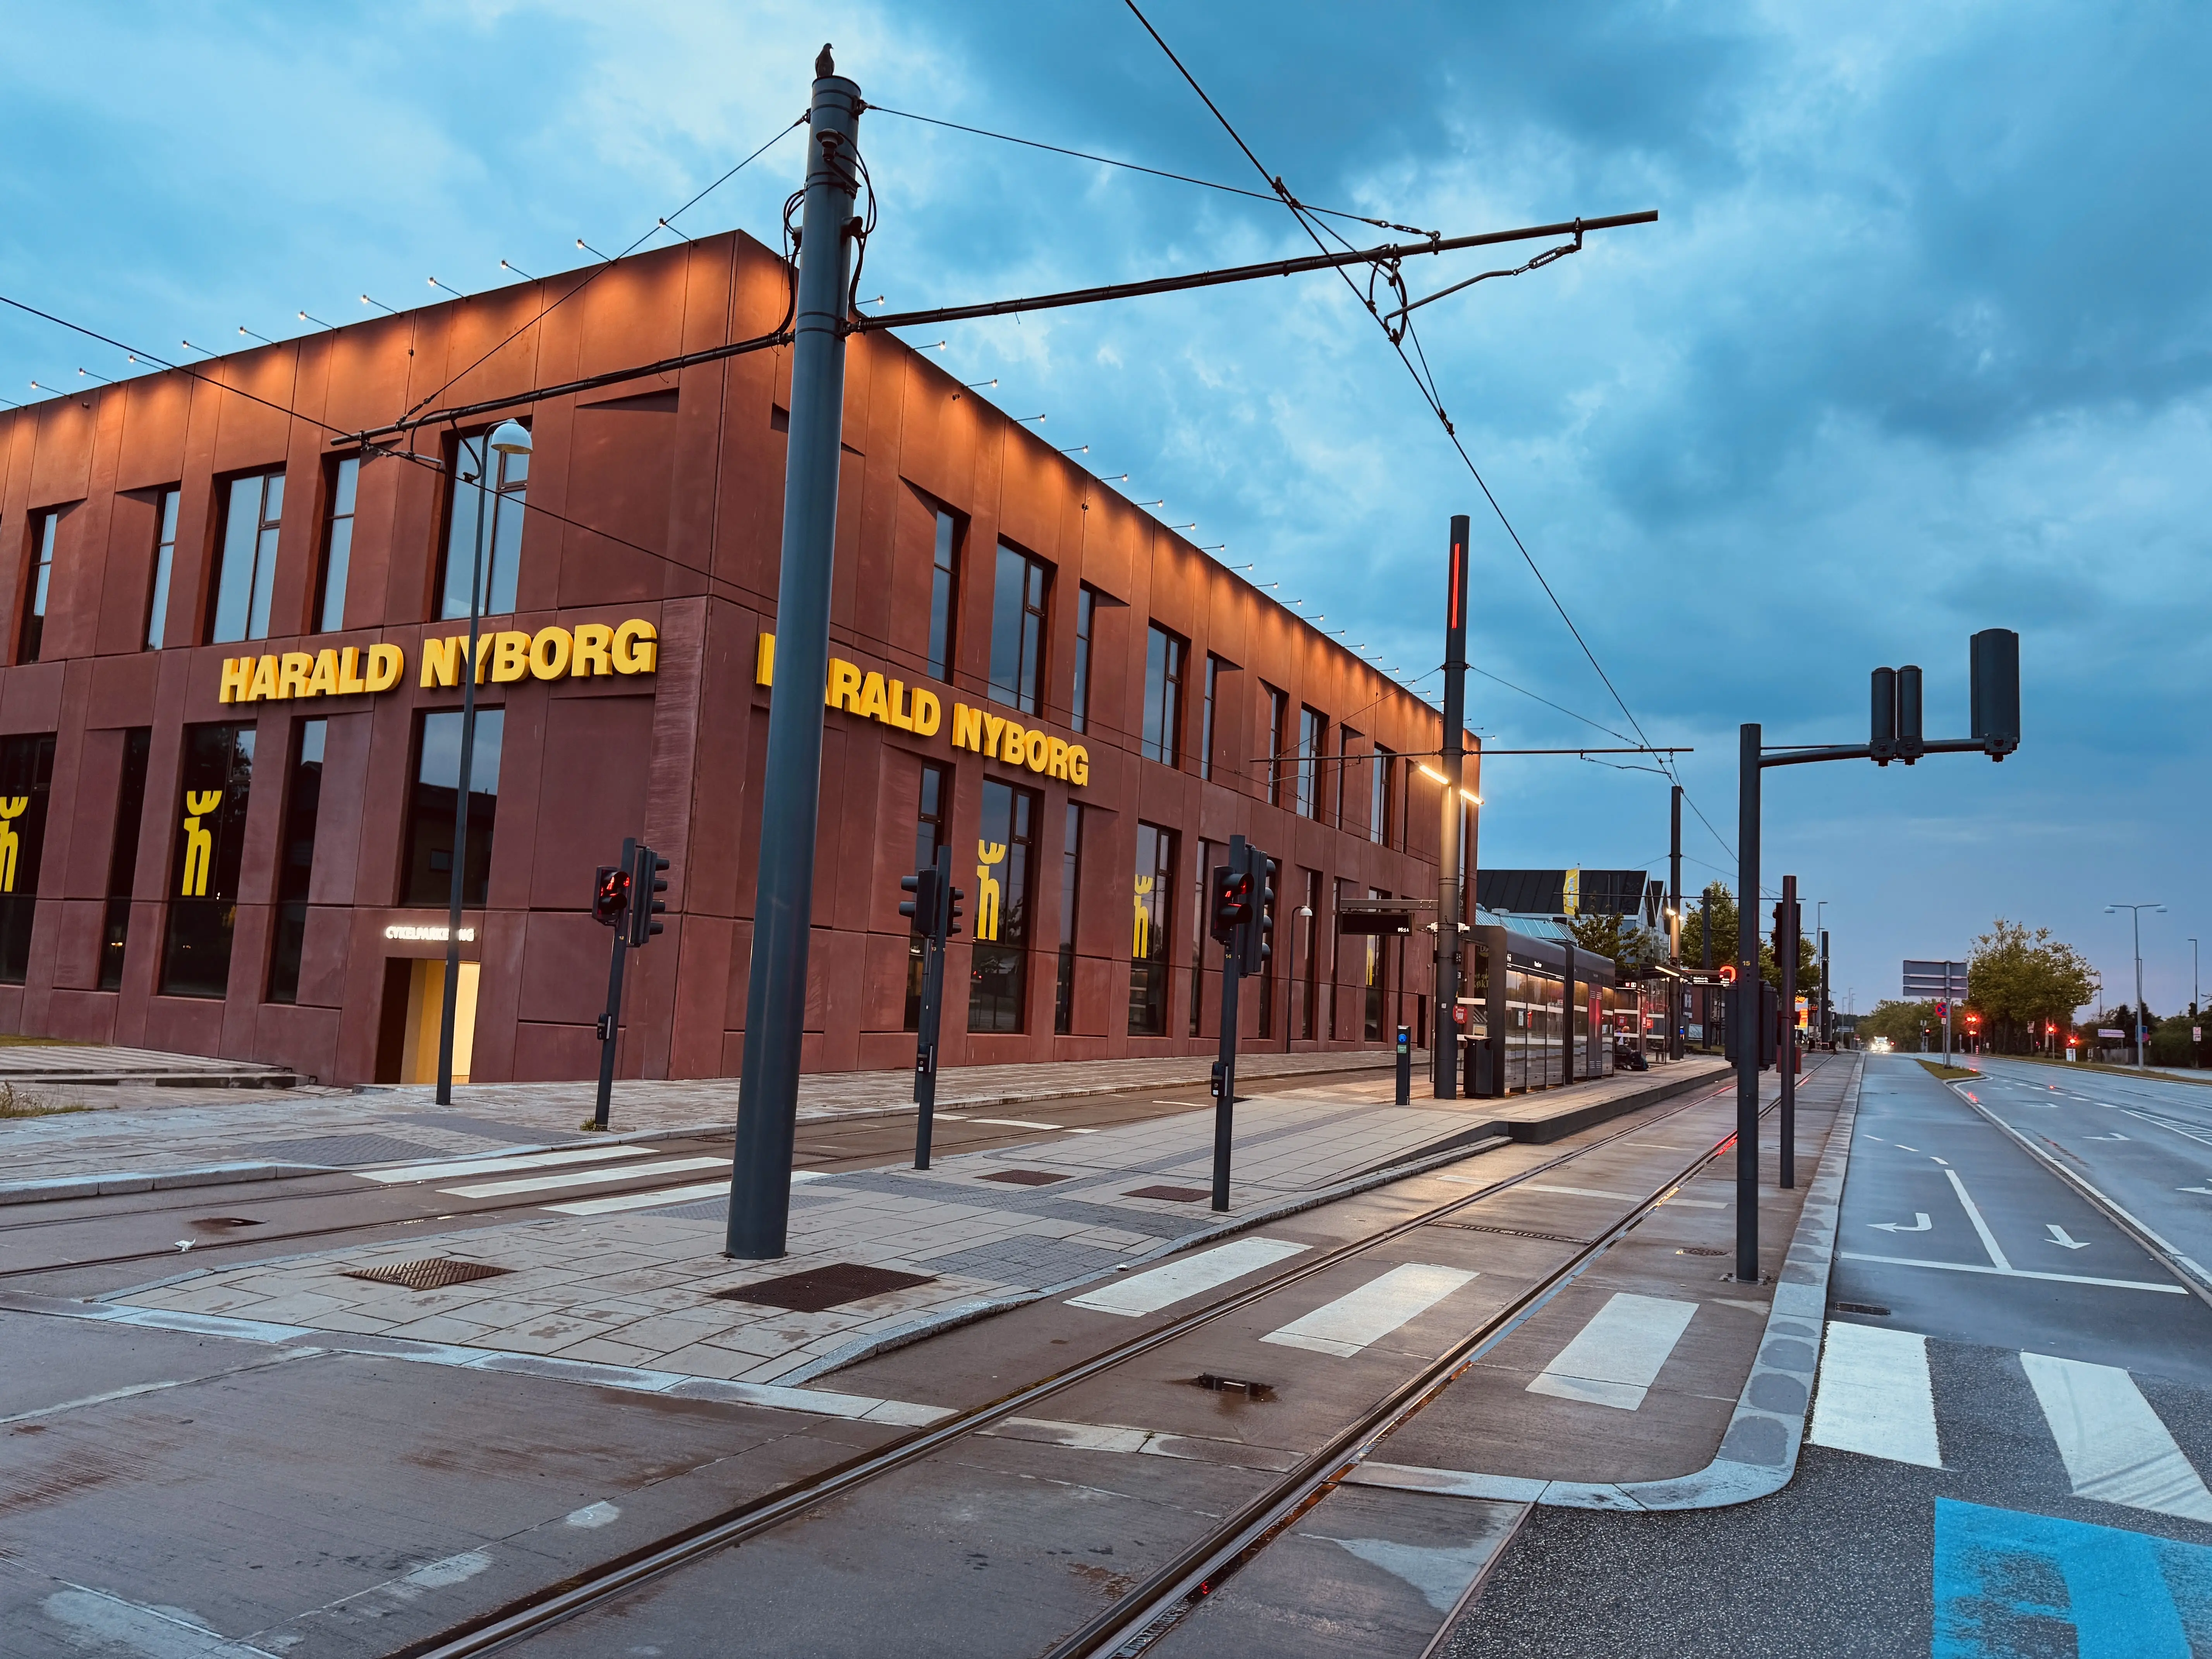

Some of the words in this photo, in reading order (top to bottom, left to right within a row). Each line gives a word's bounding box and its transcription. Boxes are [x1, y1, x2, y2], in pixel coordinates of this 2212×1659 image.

[219, 643, 404, 704] HARALD
[420, 618, 657, 688] NYBORG
[756, 632, 941, 737] RALD
[951, 702, 1089, 787] NYBORG
[385, 926, 474, 941] CYKELPARKENG
